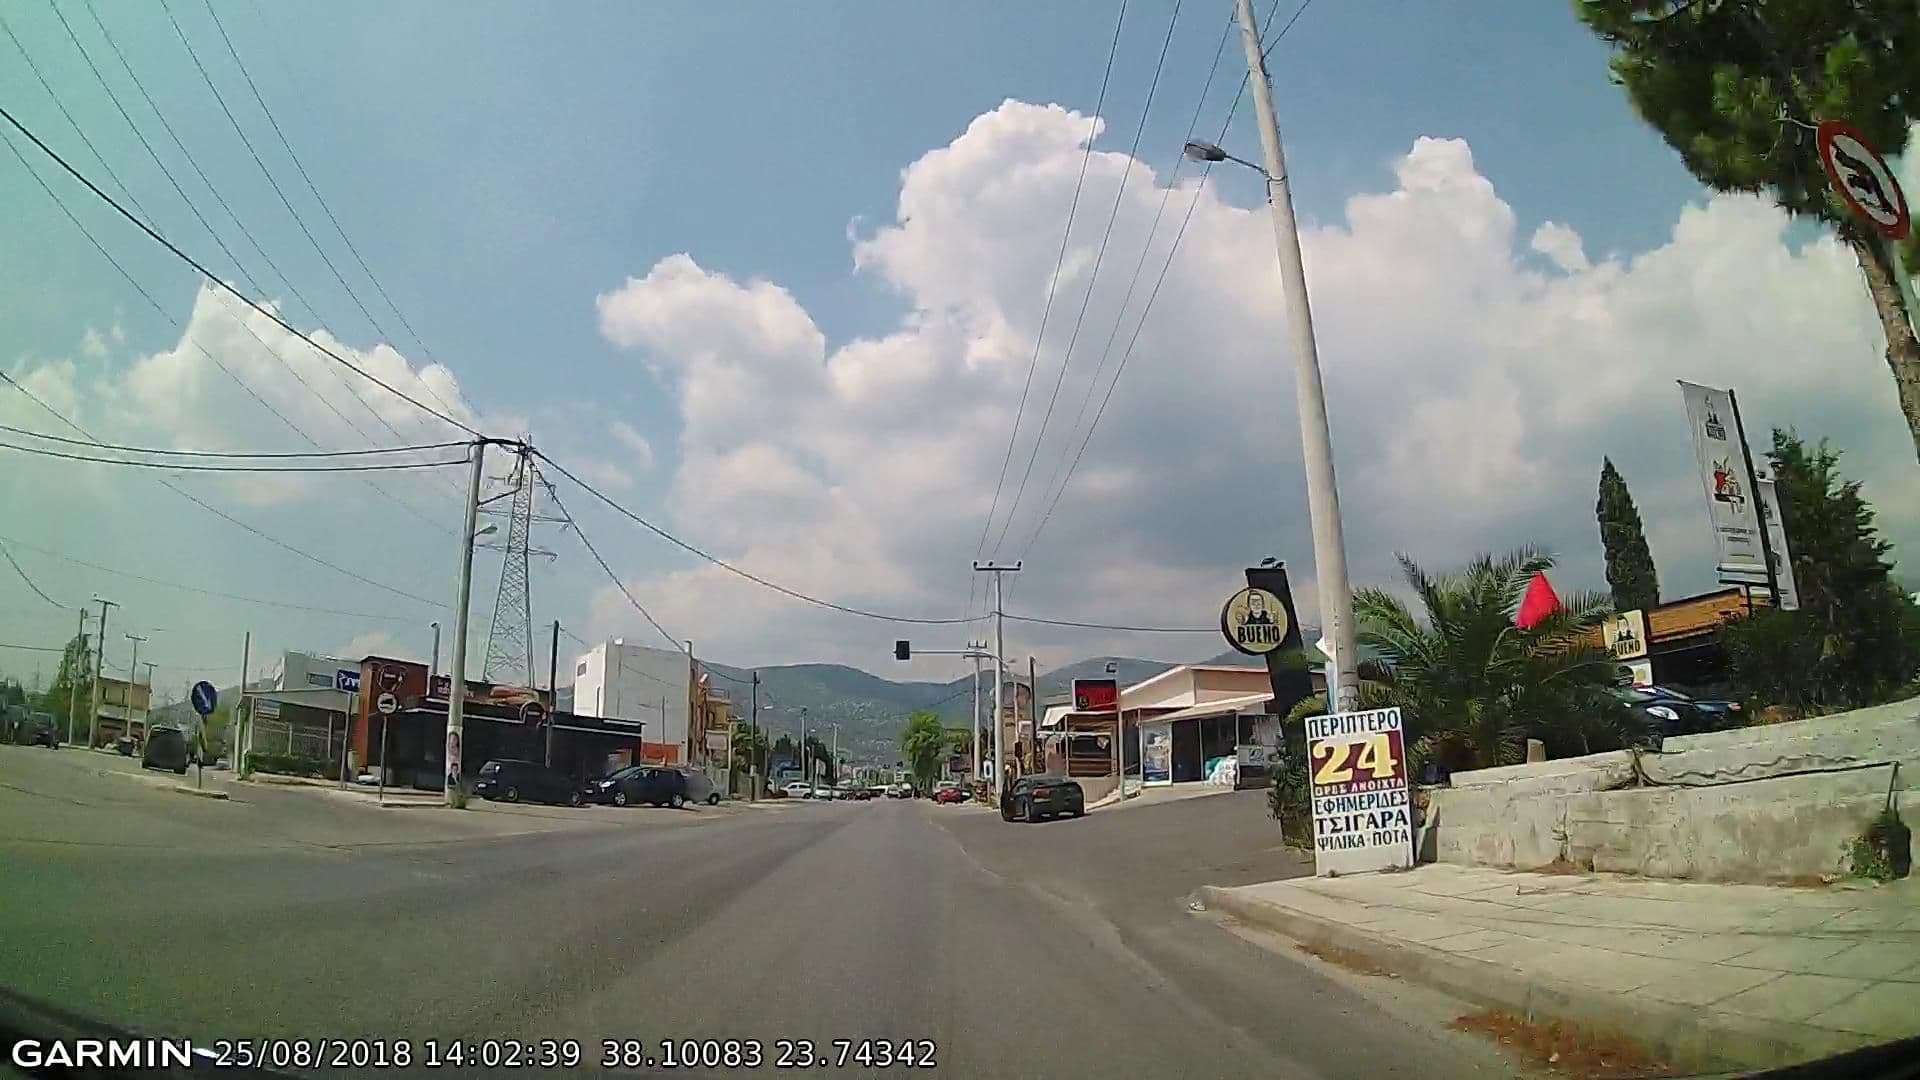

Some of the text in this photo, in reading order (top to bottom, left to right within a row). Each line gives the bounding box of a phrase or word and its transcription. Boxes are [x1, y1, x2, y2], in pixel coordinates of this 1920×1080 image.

[1237, 626, 1280, 643] BUENO
[1308, 710, 1398, 738] ΠΕΡΙΠΤΕΡΟ
[1312, 733, 1398, 785] 24
[1315, 790, 1408, 815] ΕΦΗΜΕΡΙΔΕΣ
[1315, 809, 1409, 835] ΤΣΙΓΑΡΑ
[1317, 829, 1409, 851] ΨΙΛΙΚΑ ΠΟΤΑ
